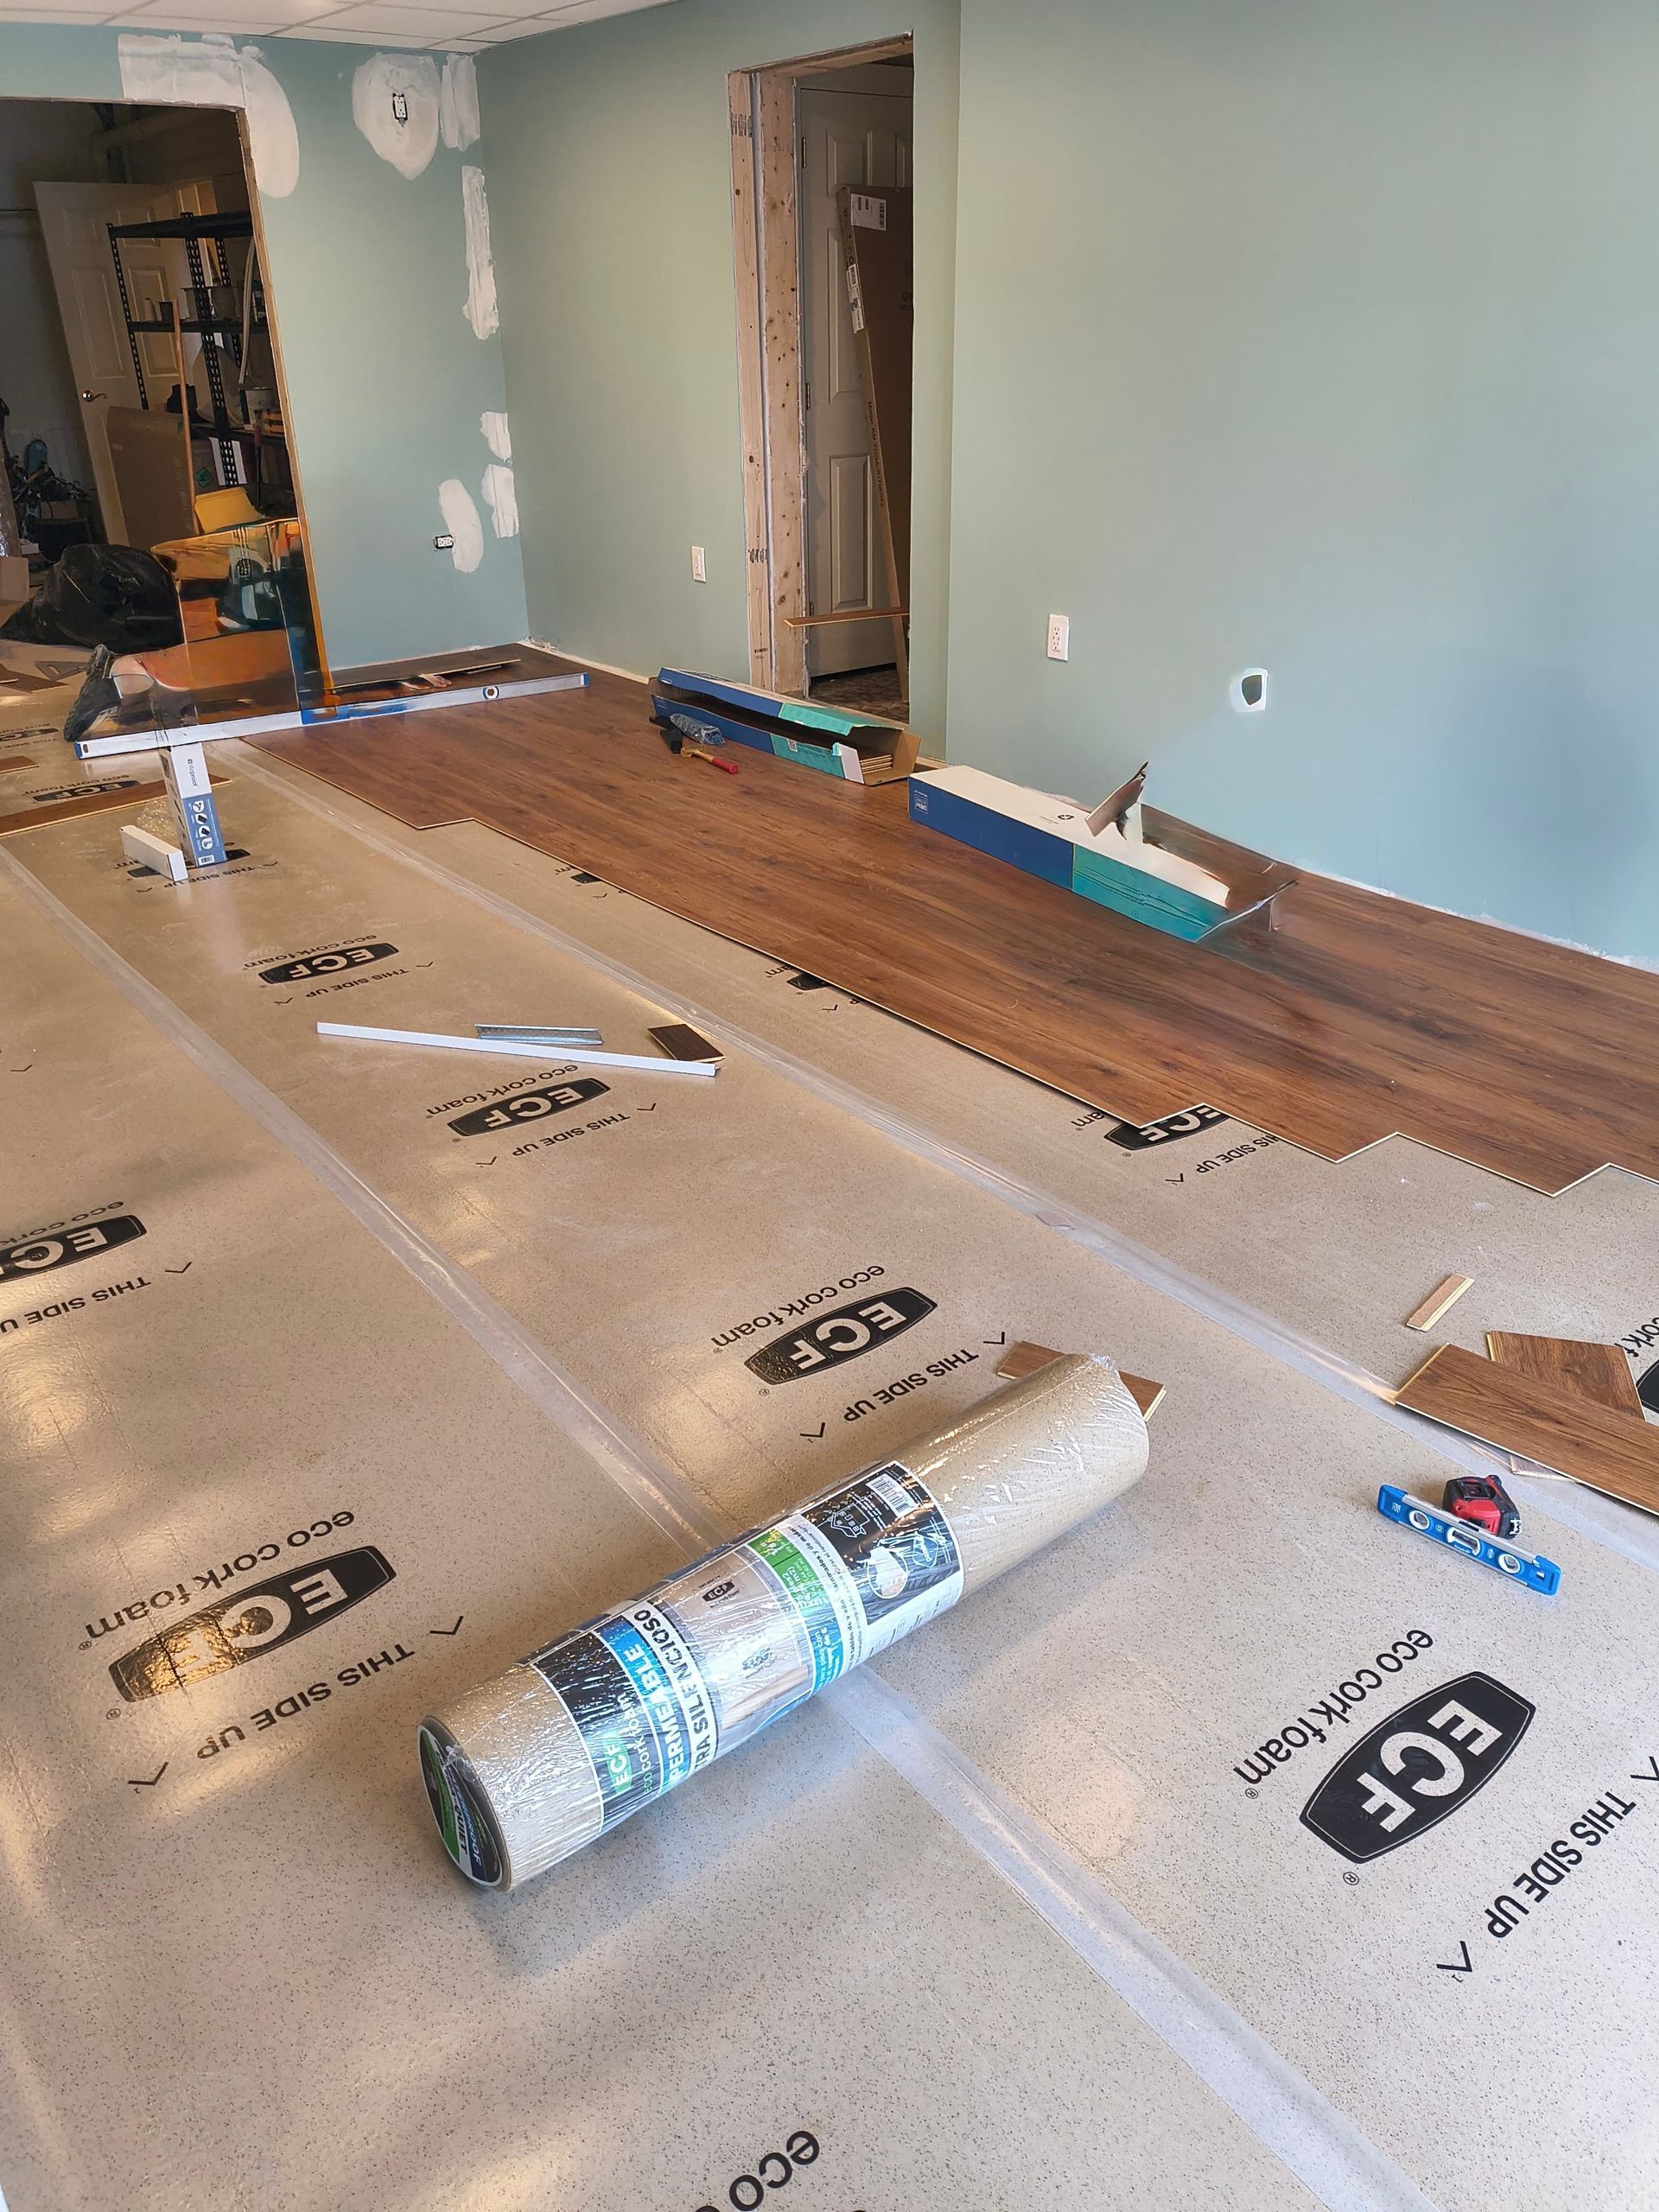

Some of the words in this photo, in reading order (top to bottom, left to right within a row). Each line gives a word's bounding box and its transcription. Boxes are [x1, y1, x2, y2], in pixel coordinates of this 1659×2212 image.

[188, 874, 219, 883] SIDE
[222, 866, 257, 876] THIS
[296, 943, 340, 958] cork
[342, 934, 378, 945] eco
[289, 948, 375, 978] ECF
[371, 969, 410, 981] THIS
[305, 988, 329, 998] UP
[330, 977, 370, 991] SIDE
[538, 1064, 579, 1080] eco
[486, 1077, 537, 1098] cork
[484, 1086, 584, 1128] ECF
[586, 1112, 632, 1131] THIS
[512, 1143, 539, 1157] UP
[539, 1128, 586, 1147] SIDE
[1253, 1135, 1281, 1147] HIS
[1196, 1159, 1221, 1173] UP
[1217, 1143, 1256, 1164] SIDE
[71, 1201, 124, 1222] eco
[0, 1221, 66, 1246] cork
[91, 1276, 152, 1302] THIS
[838, 1265, 886, 1289] eco
[24, 1297, 86, 1325] SIDE
[779, 1286, 839, 1318] cork
[0, 1319, 19, 1333] U
[789, 1300, 907, 1370] ECF
[925, 1348, 980, 1377] THIS
[873, 1373, 929, 1405] SIDE
[843, 1400, 877, 1422] UP
[286, 1510, 355, 1548] eco
[192, 1542, 281, 1591] cork
[171, 1567, 348, 1678] ECF
[814, 1631, 823, 1649] con
[1375, 1629, 1434, 1674] eco
[337, 1643, 416, 1688] THIS
[633, 1608, 710, 1735] SILENCIOSO
[250, 1681, 333, 1732] SIDE
[616, 1683, 642, 1739] foam
[1307, 1668, 1383, 1726] cork
[622, 1643, 688, 1785] PERMEABLE
[196, 1725, 247, 1760] UP
[633, 1735, 652, 1771] cork
[606, 1740, 631, 1789] ECF
[1356, 1698, 1504, 1834] ECF
[642, 1770, 654, 1796] eco
[1568, 1790, 1638, 1847] THIS
[1511, 1839, 1584, 1904] SIDE
[1484, 1893, 1531, 1939] UP
[728, 2130, 820, 2212] eco
